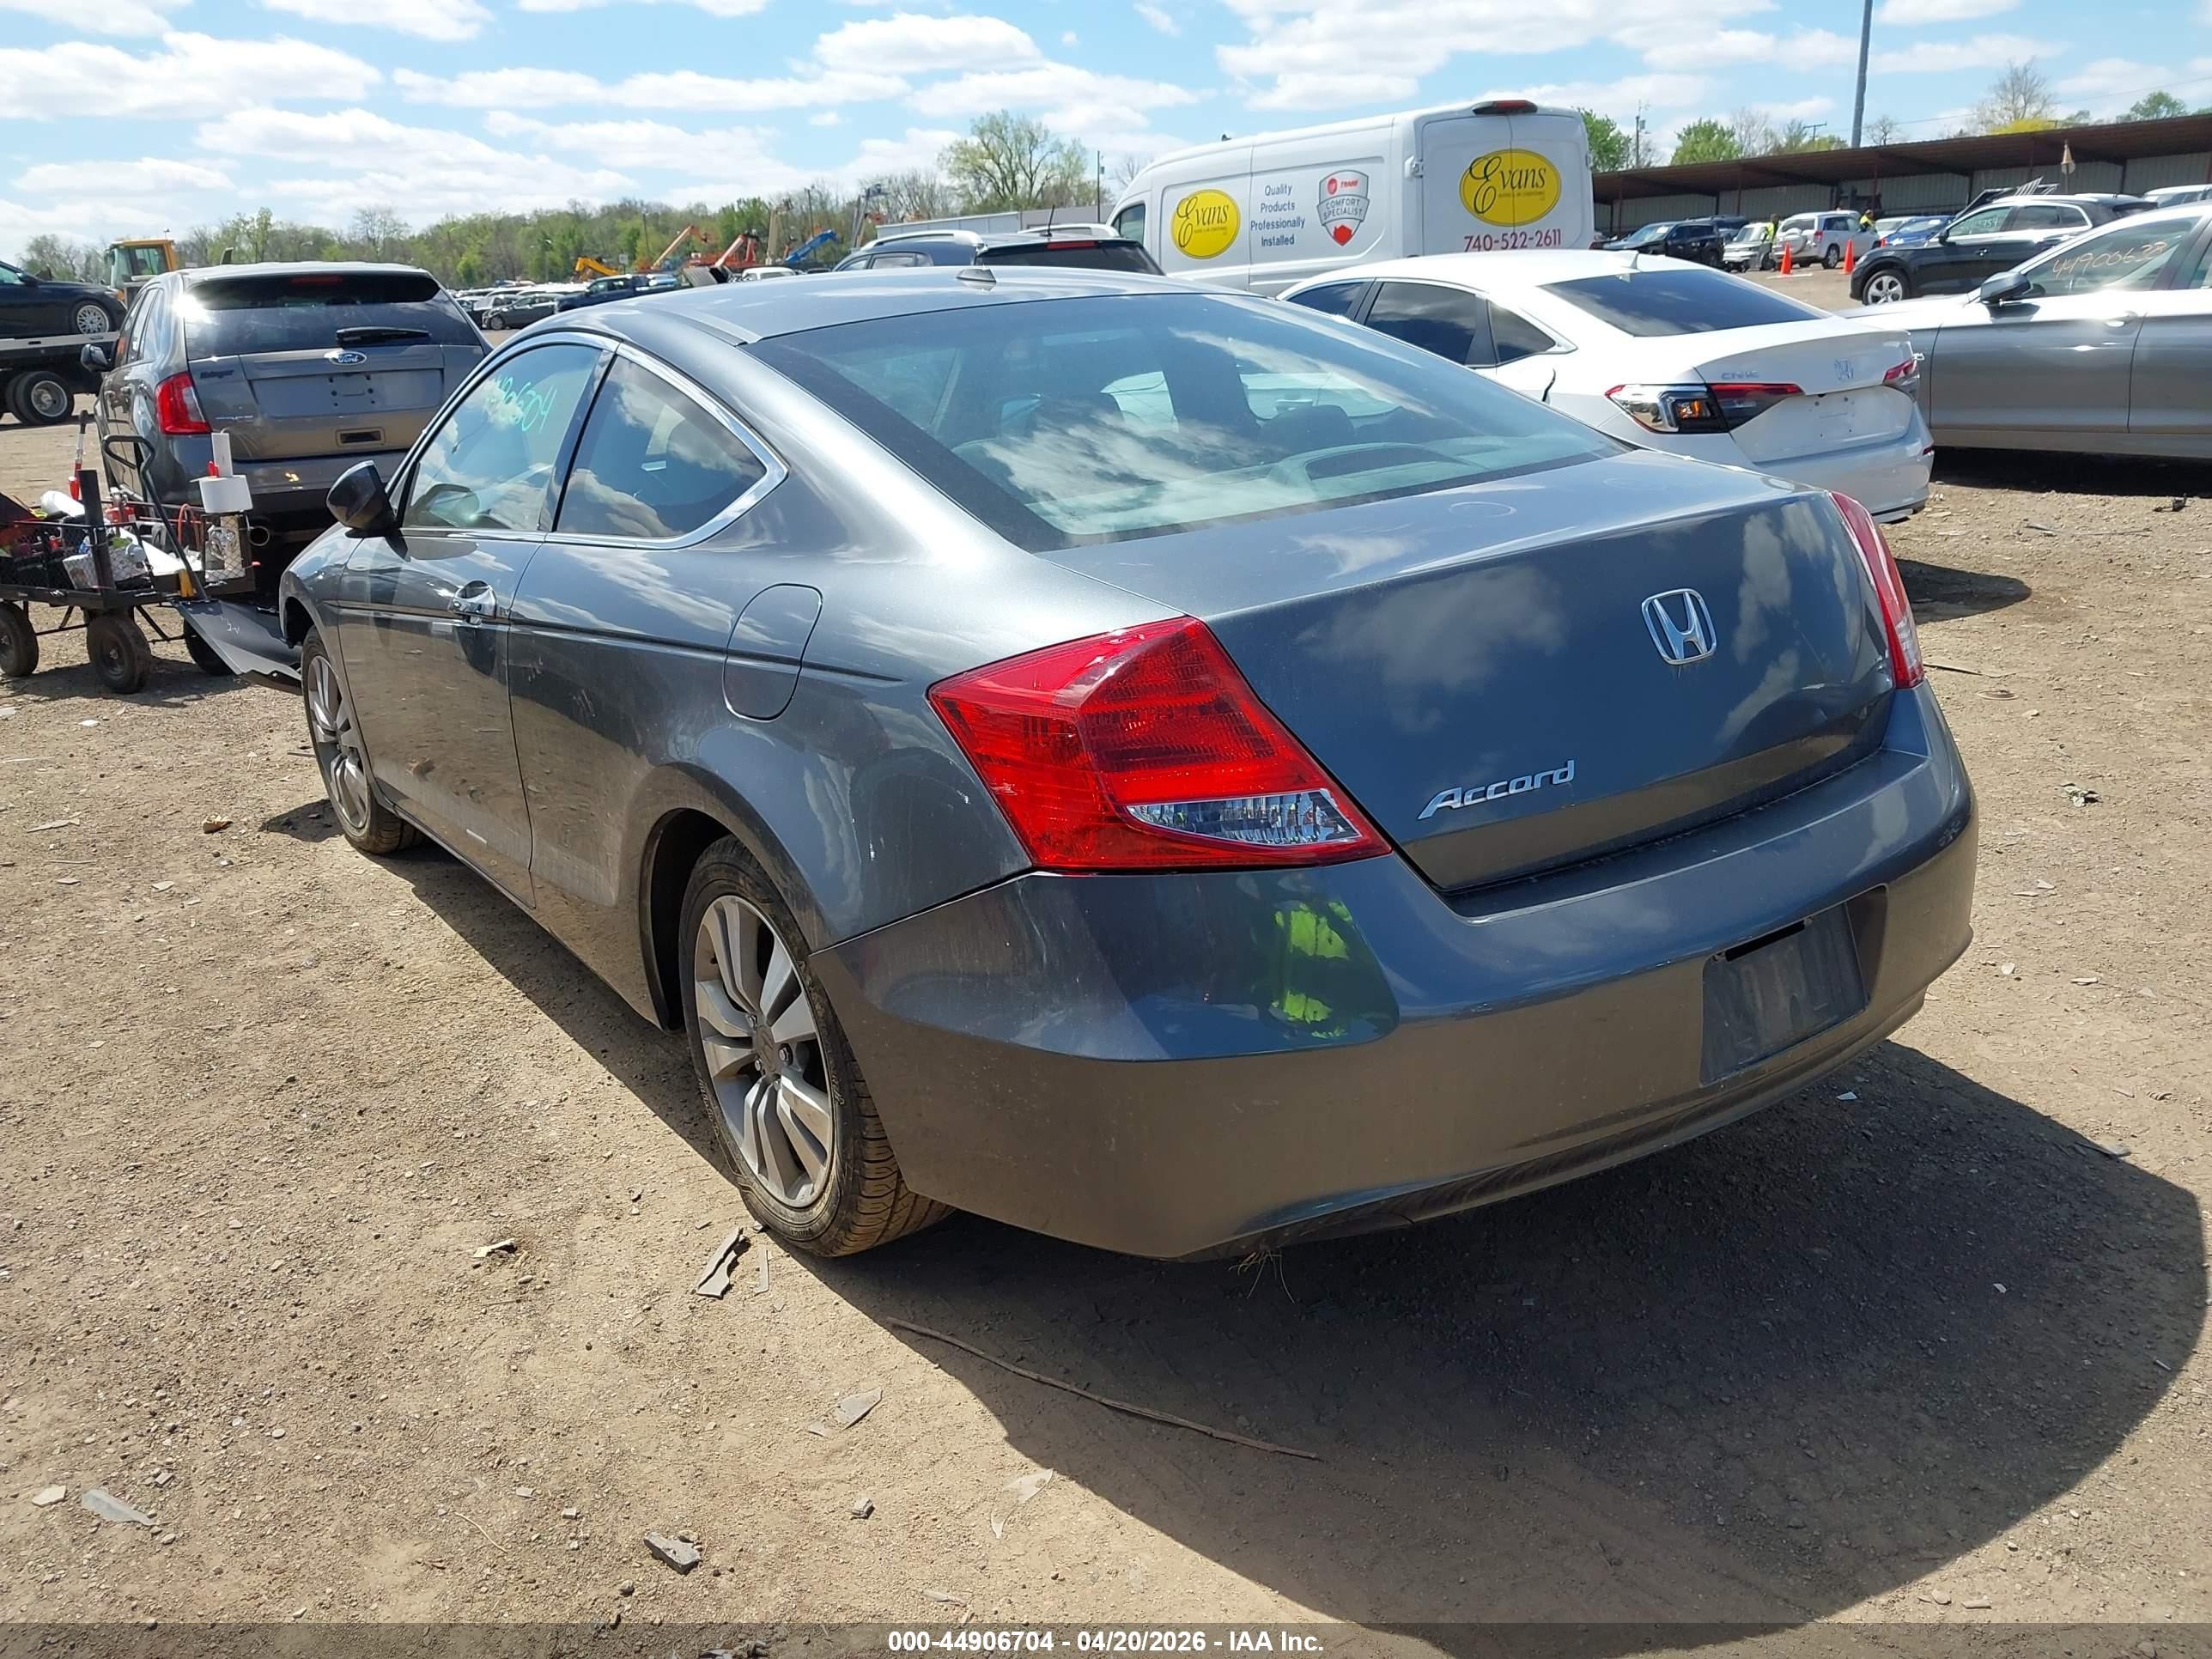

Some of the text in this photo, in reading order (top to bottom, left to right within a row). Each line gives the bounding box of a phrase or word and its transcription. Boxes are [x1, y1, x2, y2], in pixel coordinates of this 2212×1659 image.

[1265, 184, 1292, 197] Quality
[1469, 156, 1546, 214] Evans
[1261, 201, 1295, 213] Products
[1325, 198, 1360, 210] COMFORT
[1323, 207, 1363, 220] SPECIALIST
[1176, 197, 1229, 247] Evans
[1250, 216, 1305, 230] Professionally
[1261, 234, 1295, 246] Installed
[1464, 228, 1561, 252] 740-522-2611
[1417, 760, 1575, 820] Accord
